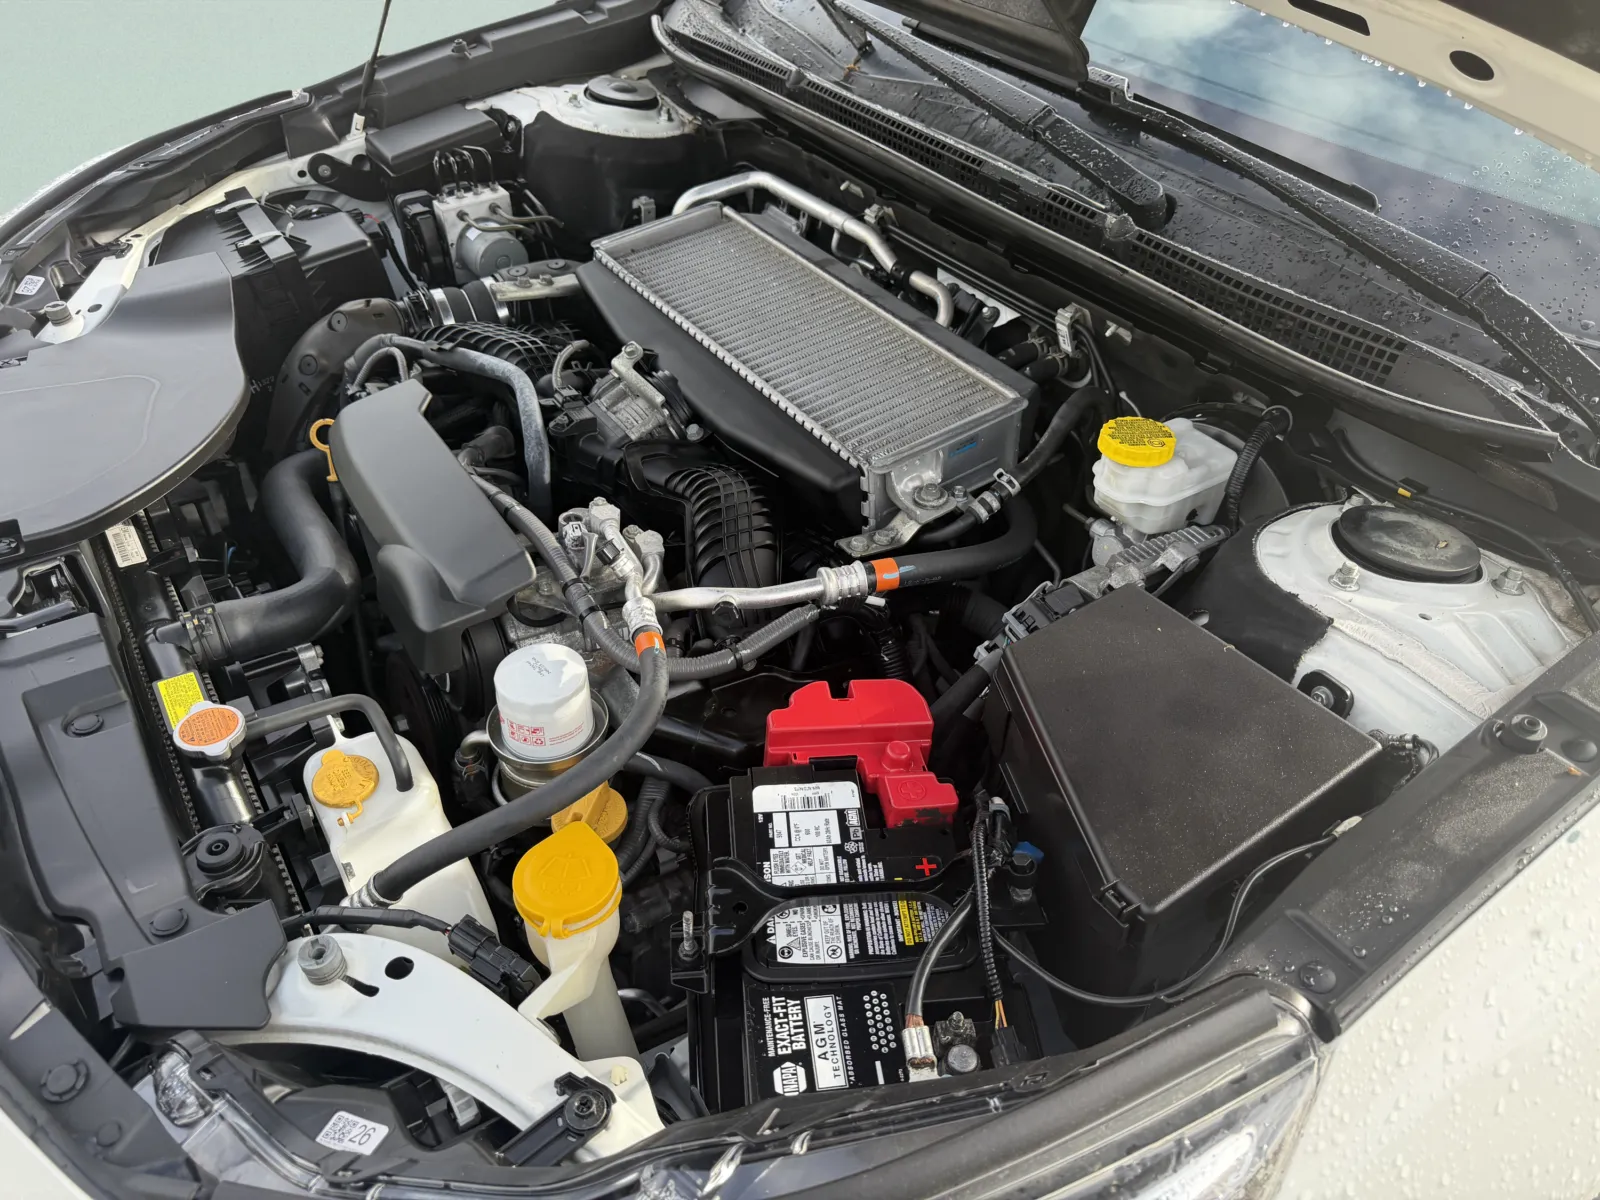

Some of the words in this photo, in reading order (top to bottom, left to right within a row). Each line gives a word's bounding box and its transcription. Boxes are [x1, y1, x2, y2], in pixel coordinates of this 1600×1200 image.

[847, 809, 858, 824] AGM
[851, 828, 860, 838] Pb
[765, 917, 775, 933] DA
[798, 922, 806, 935] GASES
[827, 923, 836, 935] REACH
[900, 910, 910, 928] ATTEMPT
[799, 936, 810, 957] EXPLOSIVE
[762, 997, 776, 1057] MAINTENANCE-FREE
[772, 996, 792, 1055] EXACT-FIT
[787, 999, 806, 1050] BATTERY
[838, 1014, 848, 1037] GLASS
[812, 1024, 829, 1060] AGM
[824, 1005, 841, 1078] TECHNOLOGY
[781, 1067, 800, 1093] NAPA
[348, 1124, 376, 1146] 26
